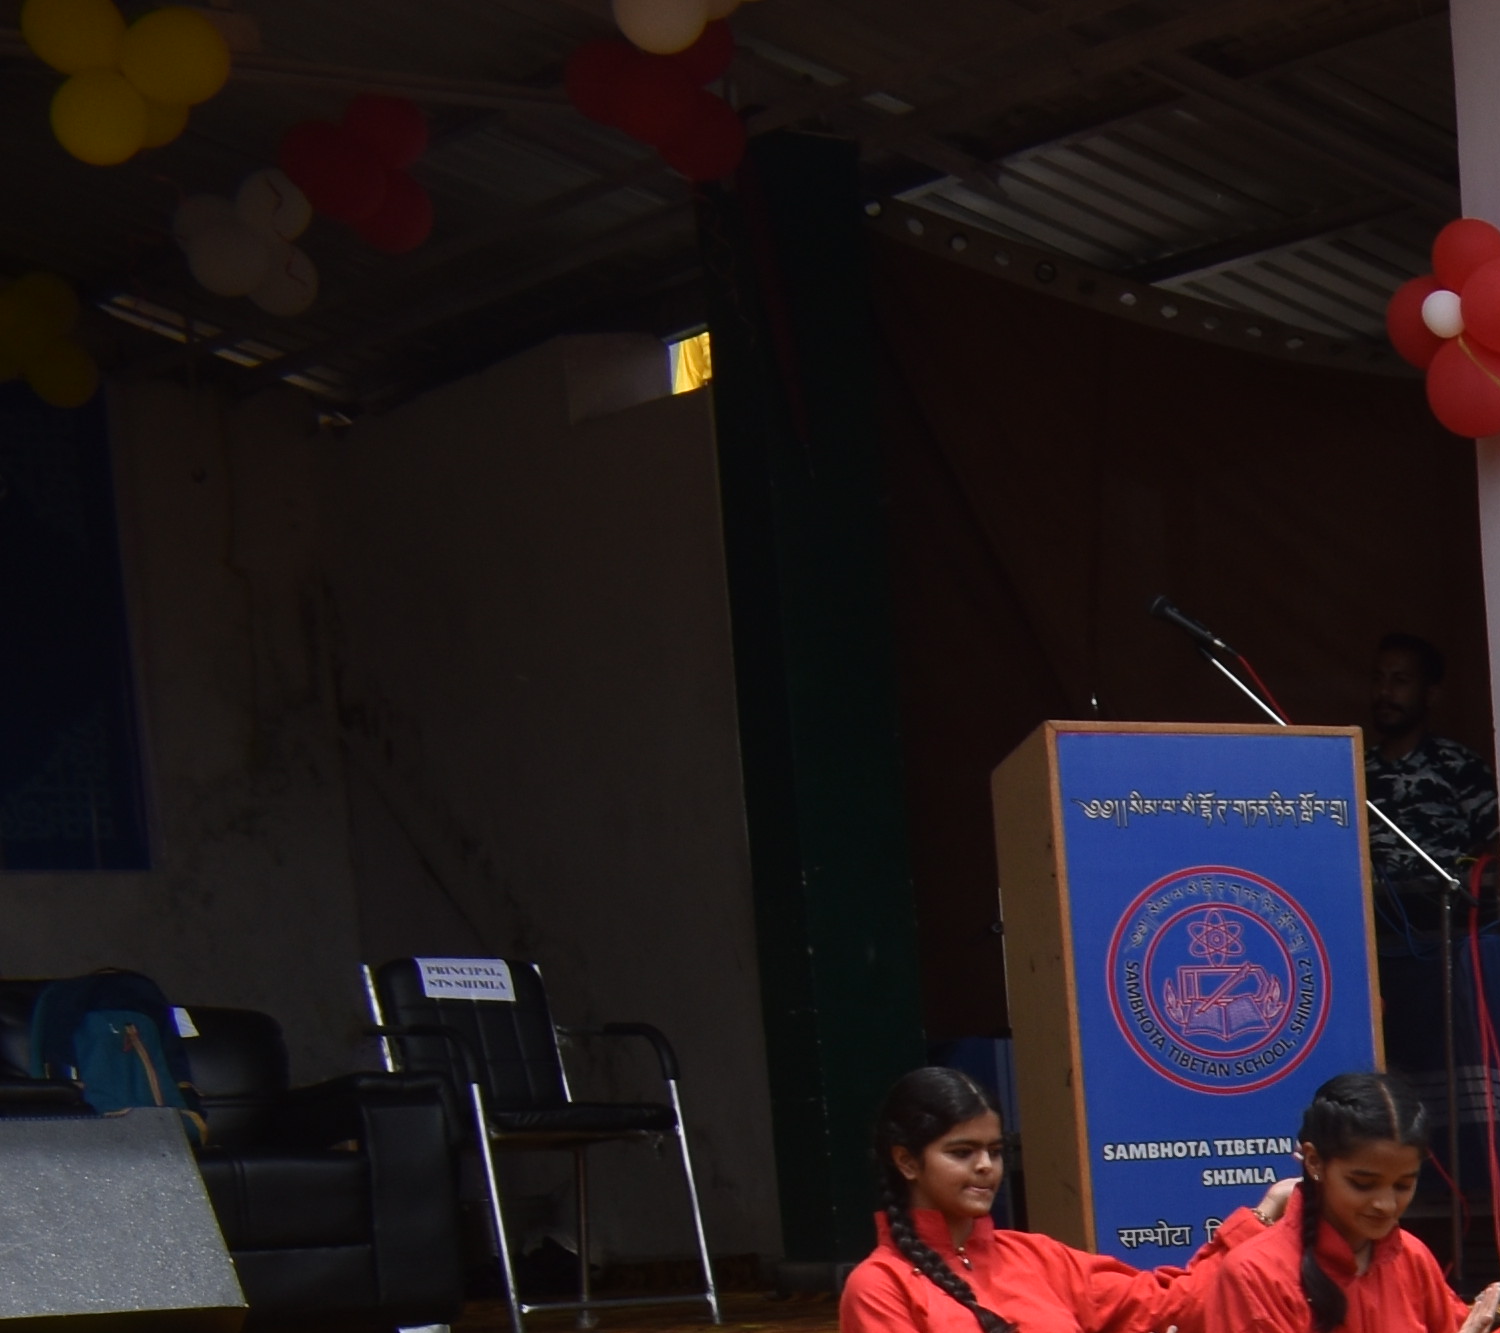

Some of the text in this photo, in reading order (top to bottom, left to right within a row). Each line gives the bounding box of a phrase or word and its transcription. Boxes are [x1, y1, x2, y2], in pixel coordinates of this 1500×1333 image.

[455, 980, 507, 990] SHIMLA
[1125, 957, 1315, 1077] SAMBHOTA TIBETAN SCHOOL, SHIMLA-2
[1103, 1137, 1293, 1160] SAMBHOTA TIBETAN
[1203, 1167, 1277, 1186] SHIMLA
[1117, 1220, 1192, 1249] सम्भोटा
